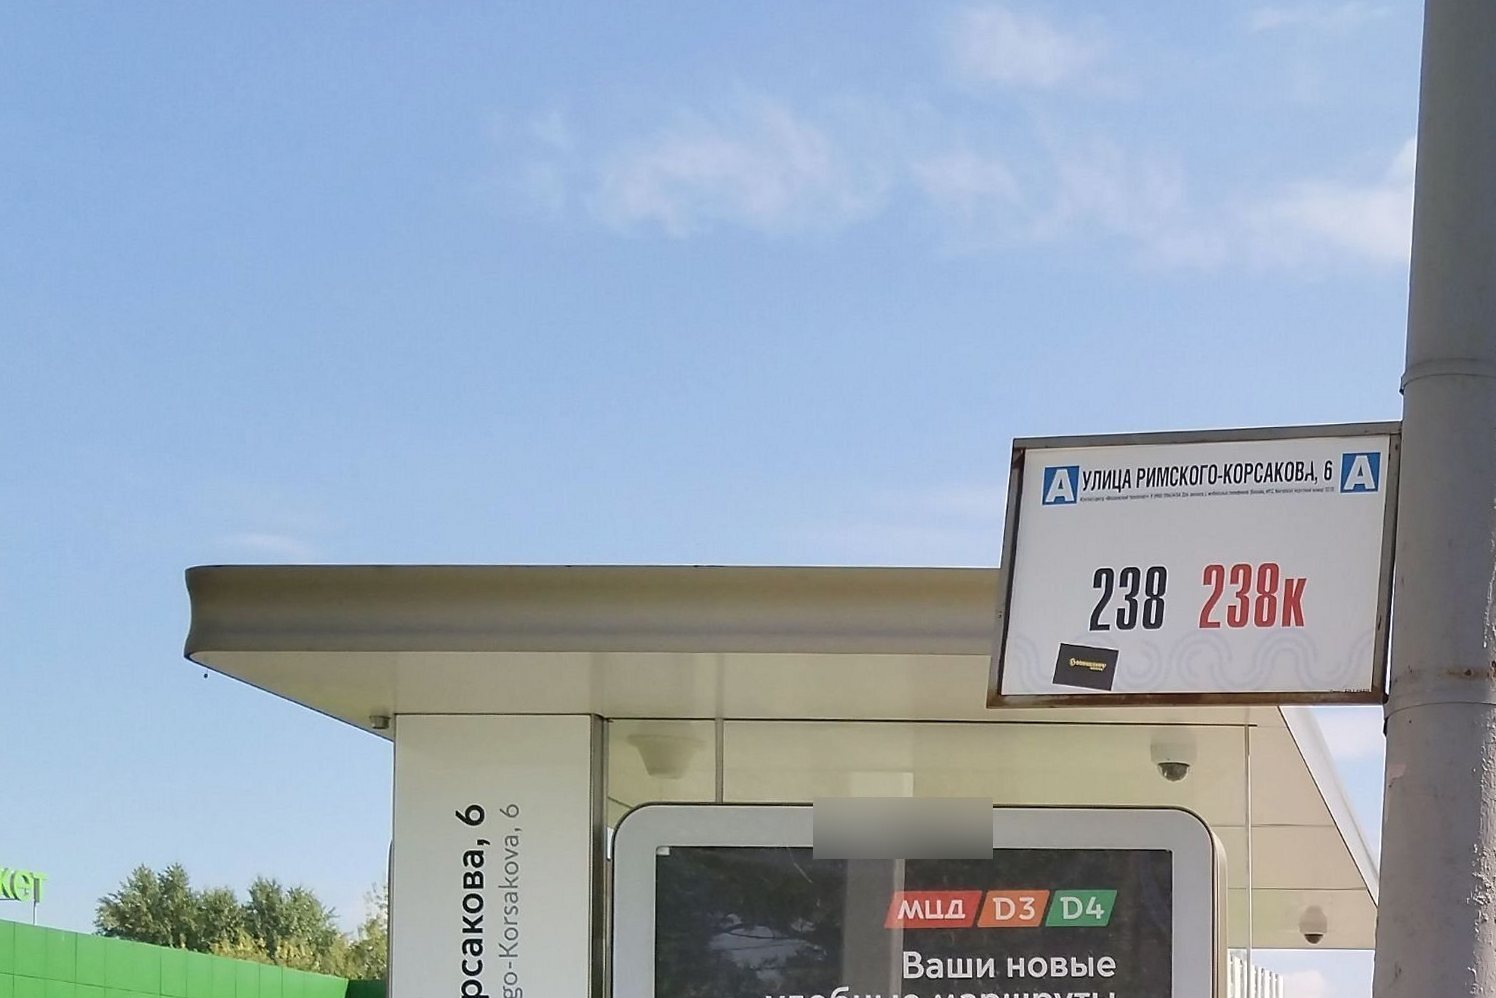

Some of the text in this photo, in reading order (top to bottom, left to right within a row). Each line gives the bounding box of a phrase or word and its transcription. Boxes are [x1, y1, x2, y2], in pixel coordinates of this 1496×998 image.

[1082, 468, 1132, 493] УЛИЦА
[1136, 460, 1318, 489] РИМСКОГО-КОРСАКОВА,
[1323, 460, 1333, 481] 6
[1089, 566, 1168, 631] 238
[455, 803, 486, 827] 6
[500, 803, 521, 816] 6
[897, 897, 1105, 921] МЦД D3 D4
[902, 950, 1117, 980] Ваши новые
